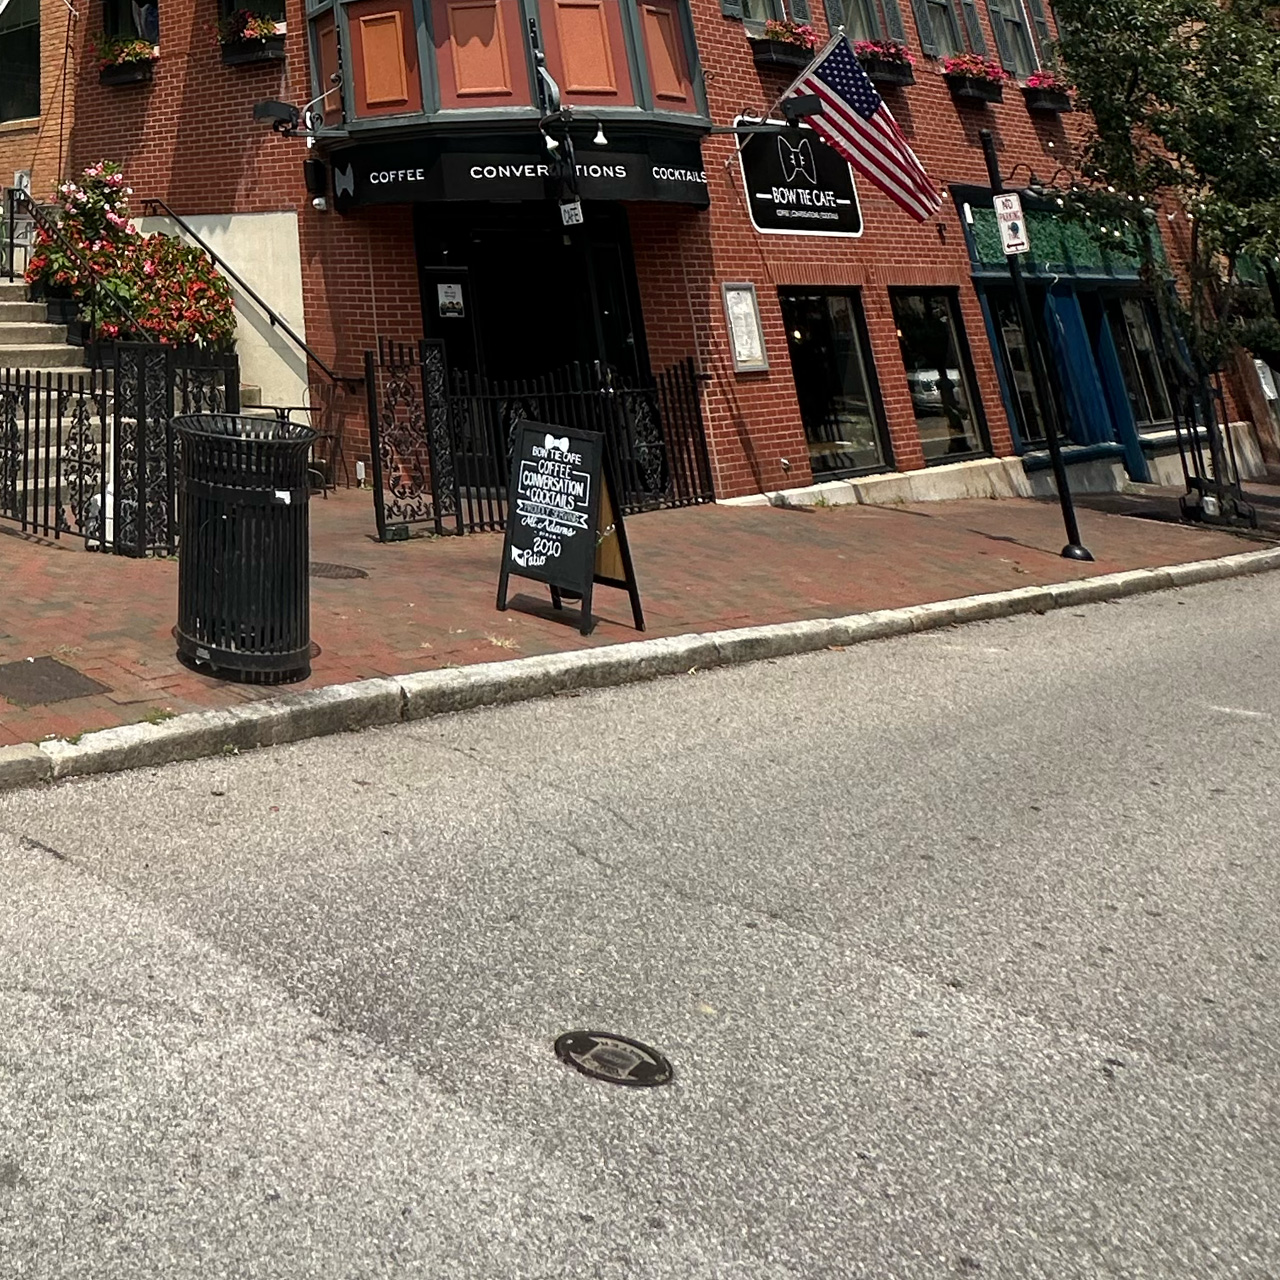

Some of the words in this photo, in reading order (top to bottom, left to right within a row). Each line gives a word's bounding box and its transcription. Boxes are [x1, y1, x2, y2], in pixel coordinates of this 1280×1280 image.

[369, 168, 425, 184] COFFEE
[470, 165, 627, 179] CONVERTIONS
[652, 166, 708, 183] COCKTAILS
[772, 186, 796, 204] BOW
[797, 189, 813, 206] TIE
[812, 190, 837, 207] CAFE
[1002, 198, 1014, 210] NO
[532, 445, 548, 458] BOW
[549, 449, 562, 461] TIE
[562, 452, 582, 465] CAFE
[538, 459, 572, 479] COFFEE
[523, 470, 584, 497] CONVERSATION
[531, 487, 575, 510] COCKTAILS
[533, 537, 561, 557] 2010
[523, 549, 547, 567] Patio
